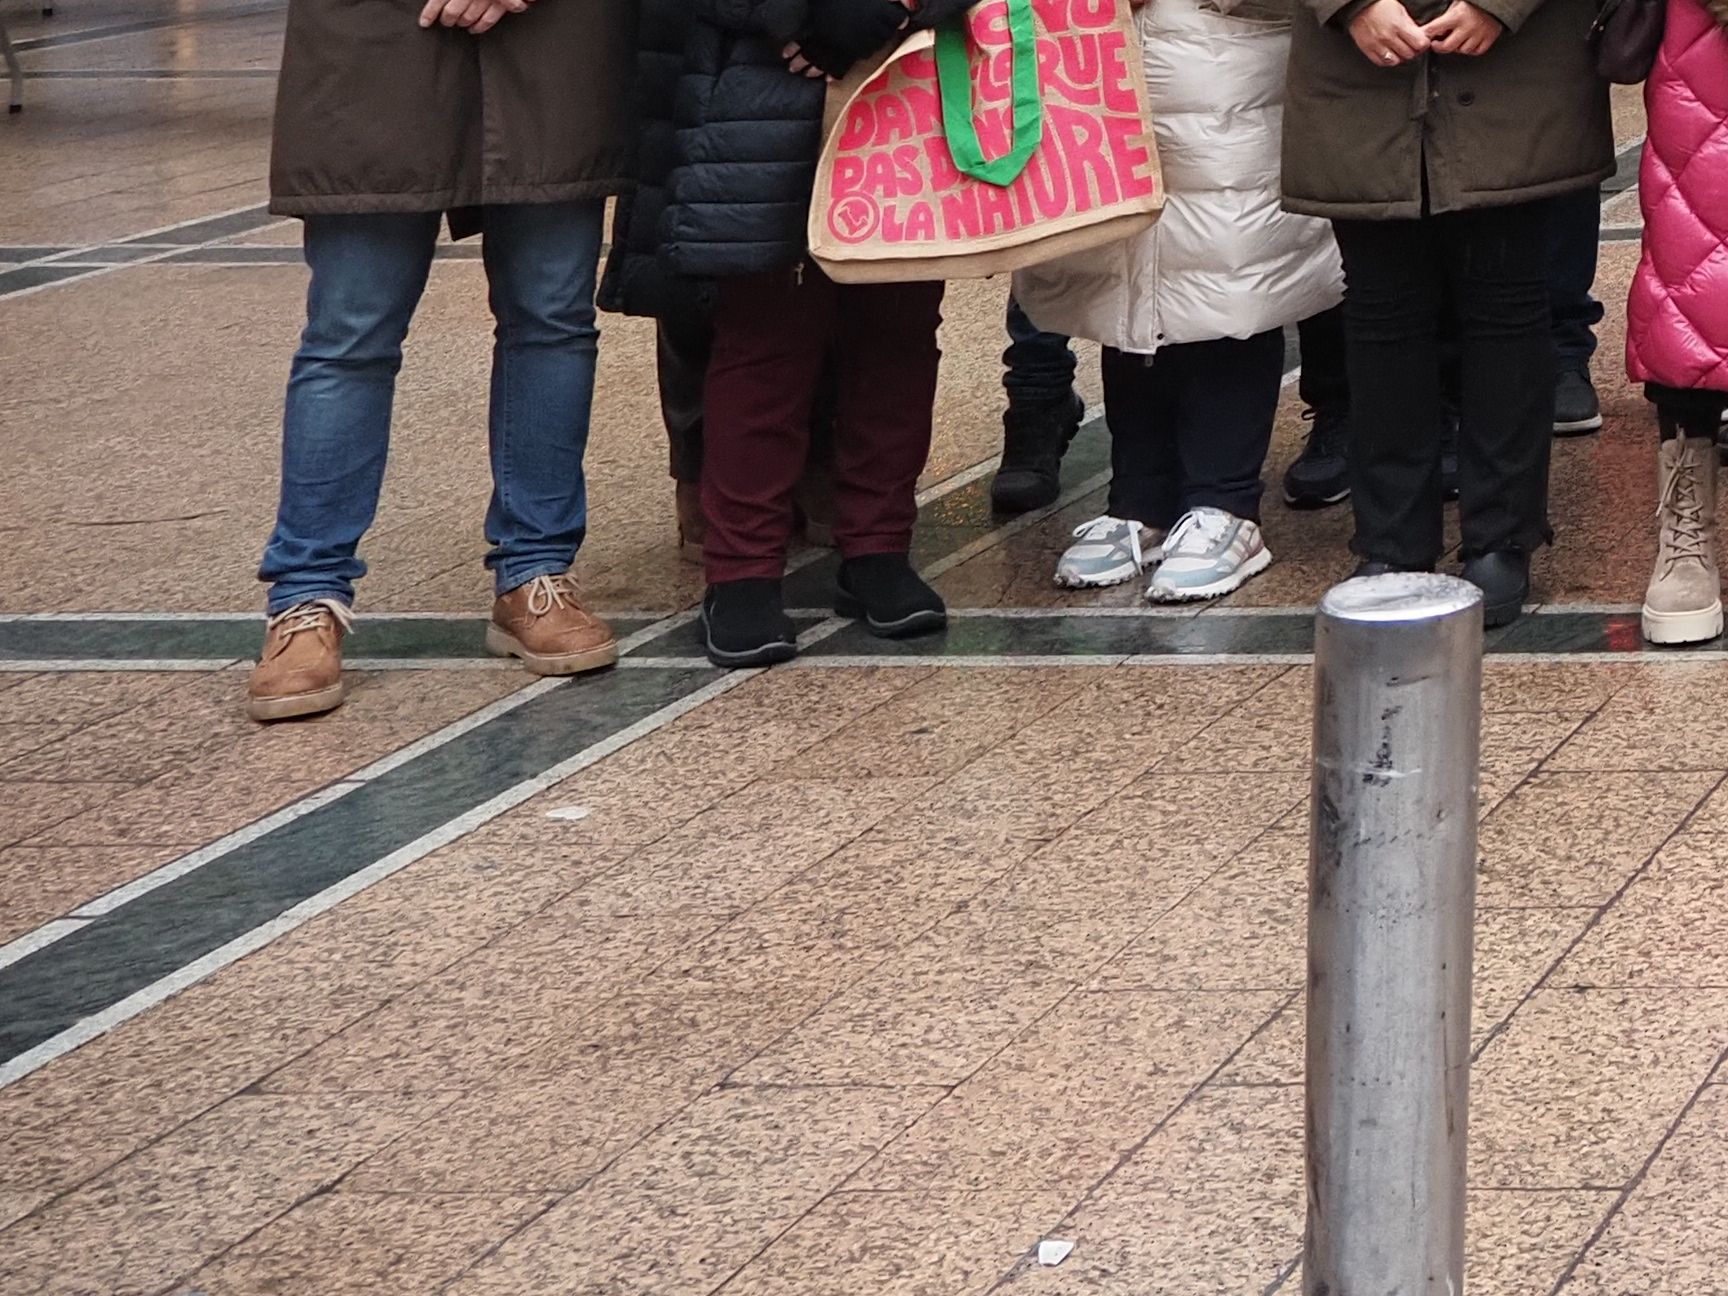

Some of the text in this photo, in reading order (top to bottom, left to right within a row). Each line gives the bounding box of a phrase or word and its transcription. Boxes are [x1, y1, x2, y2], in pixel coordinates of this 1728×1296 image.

[837, 81, 948, 151] DAN
[1038, 30, 1140, 114] RUE
[831, 144, 924, 199] PAS
[880, 200, 937, 244] LA
